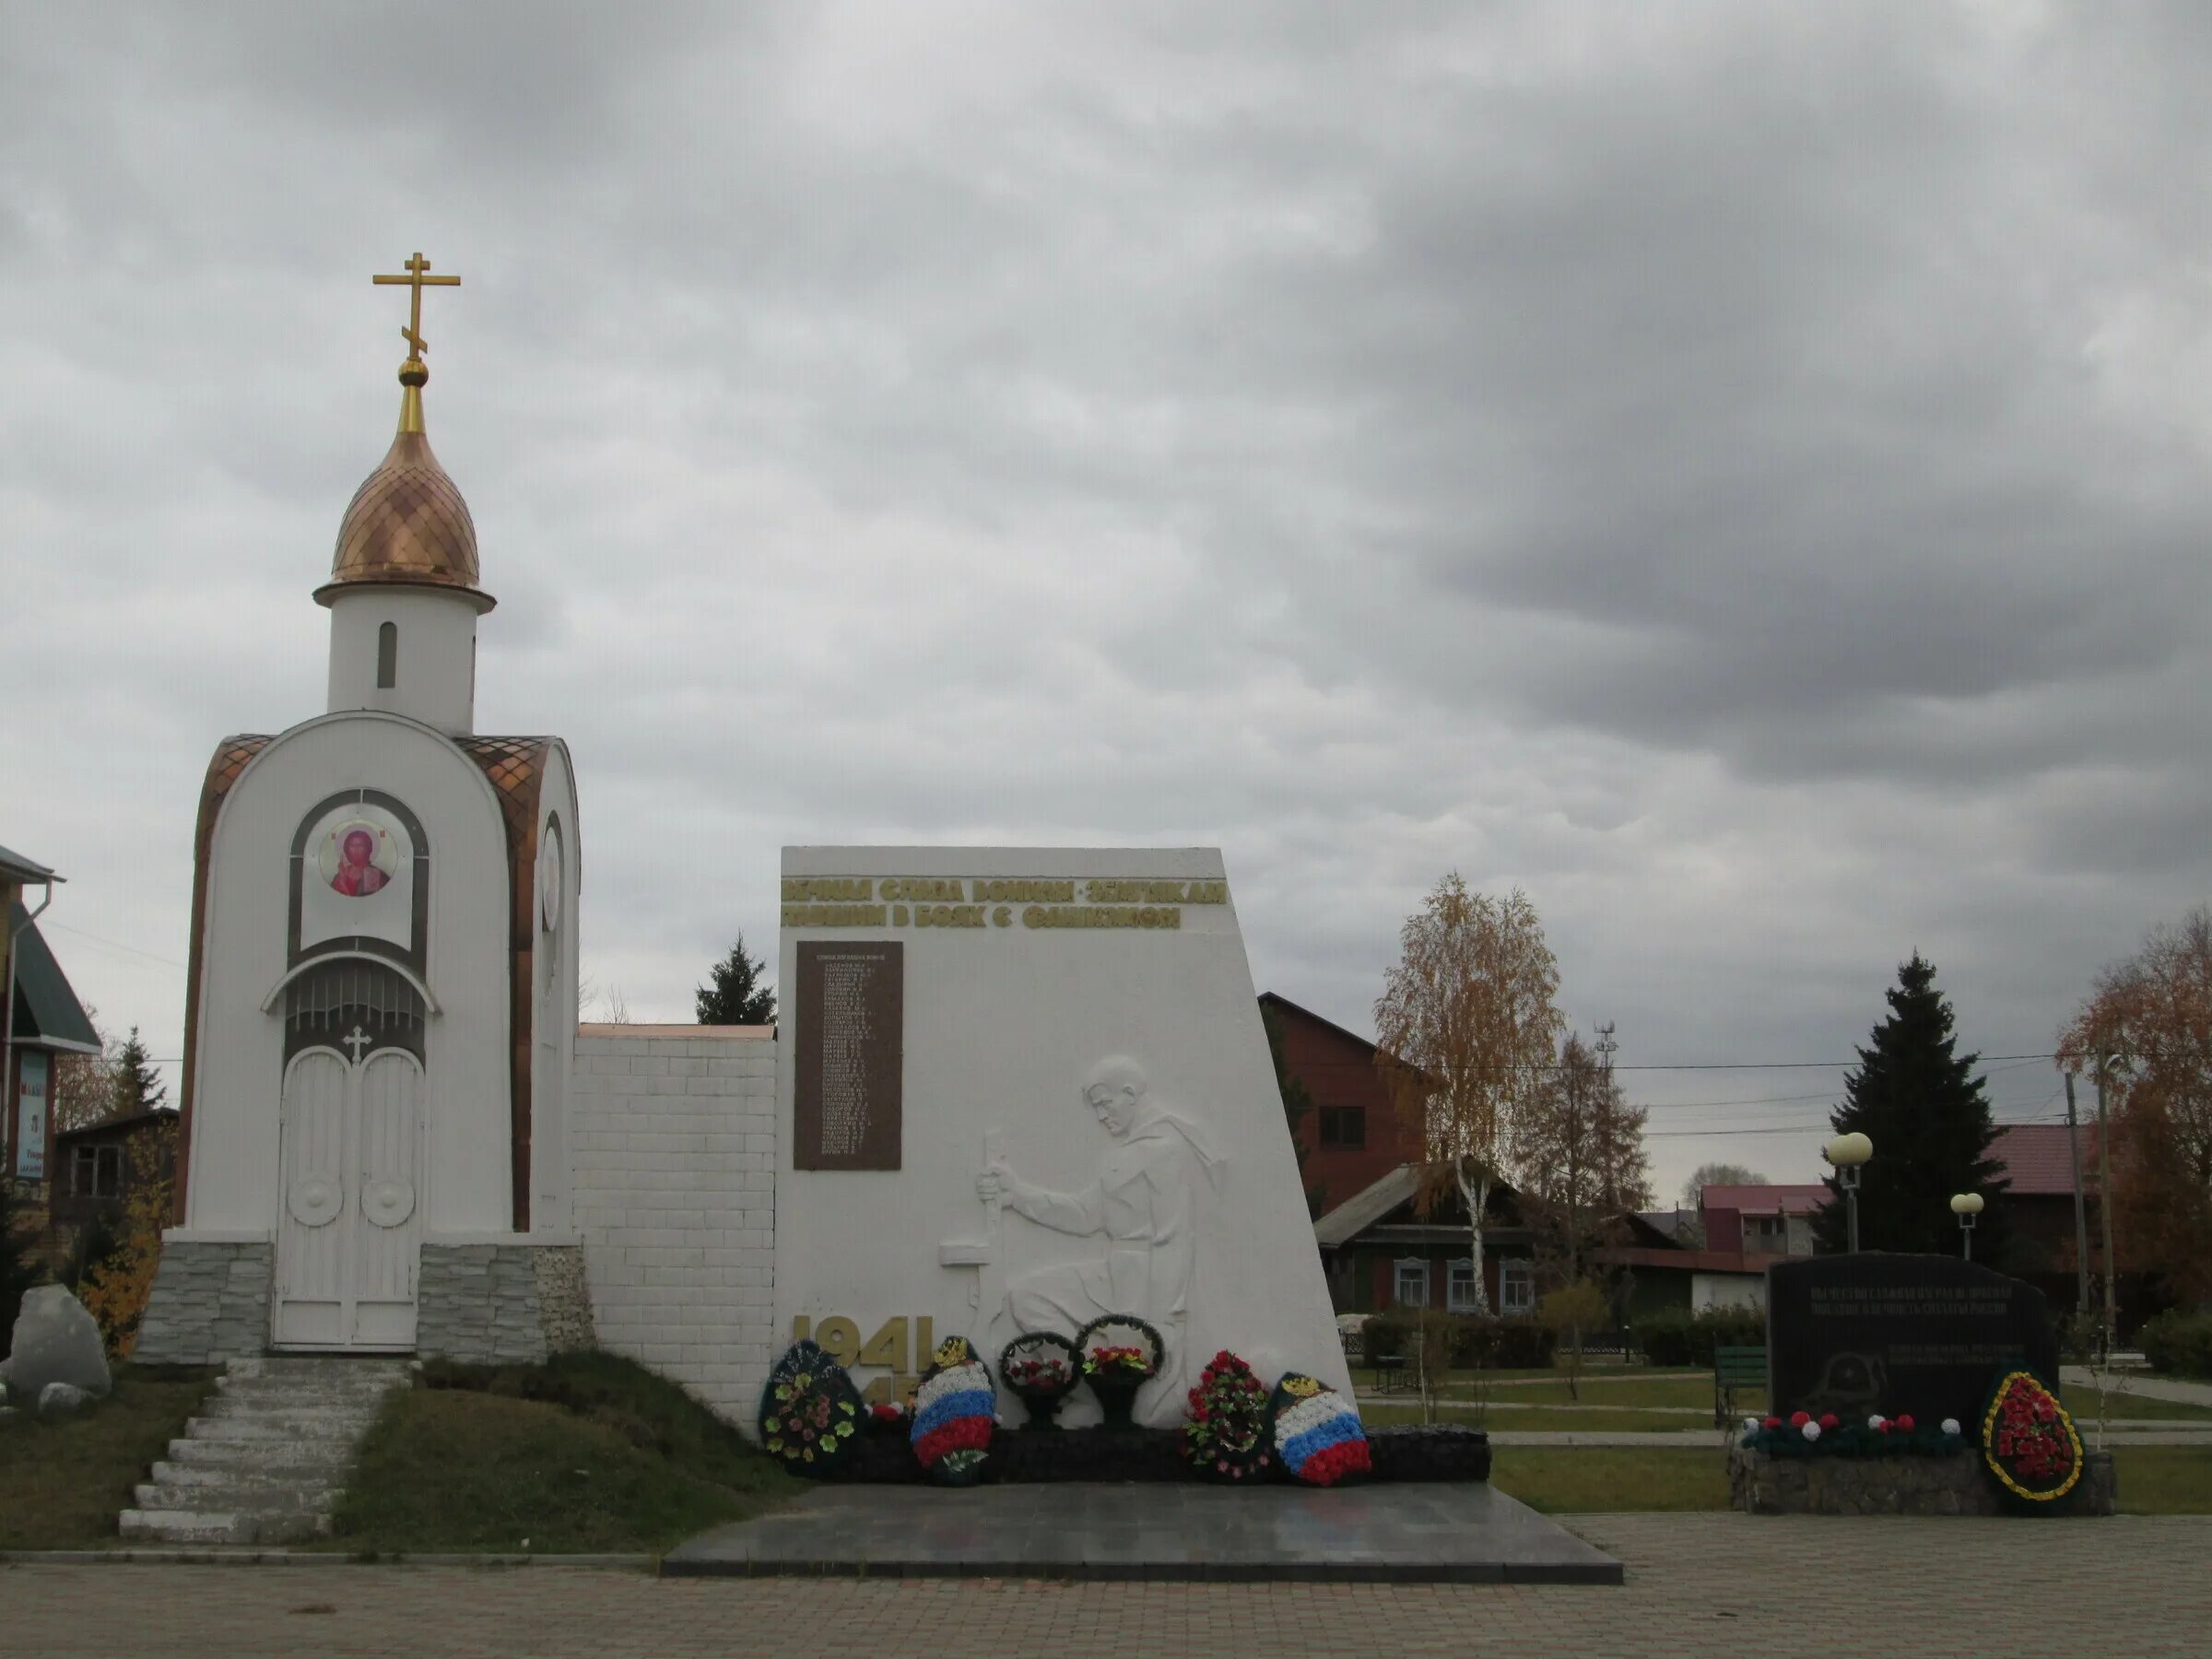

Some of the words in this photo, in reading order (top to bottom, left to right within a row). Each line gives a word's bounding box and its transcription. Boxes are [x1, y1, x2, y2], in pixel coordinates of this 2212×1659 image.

[879, 879, 966, 901] СЛАВА
[893, 905, 910, 927] В
[914, 905, 987, 928] БОЯХ
[992, 906, 1013, 928] С
